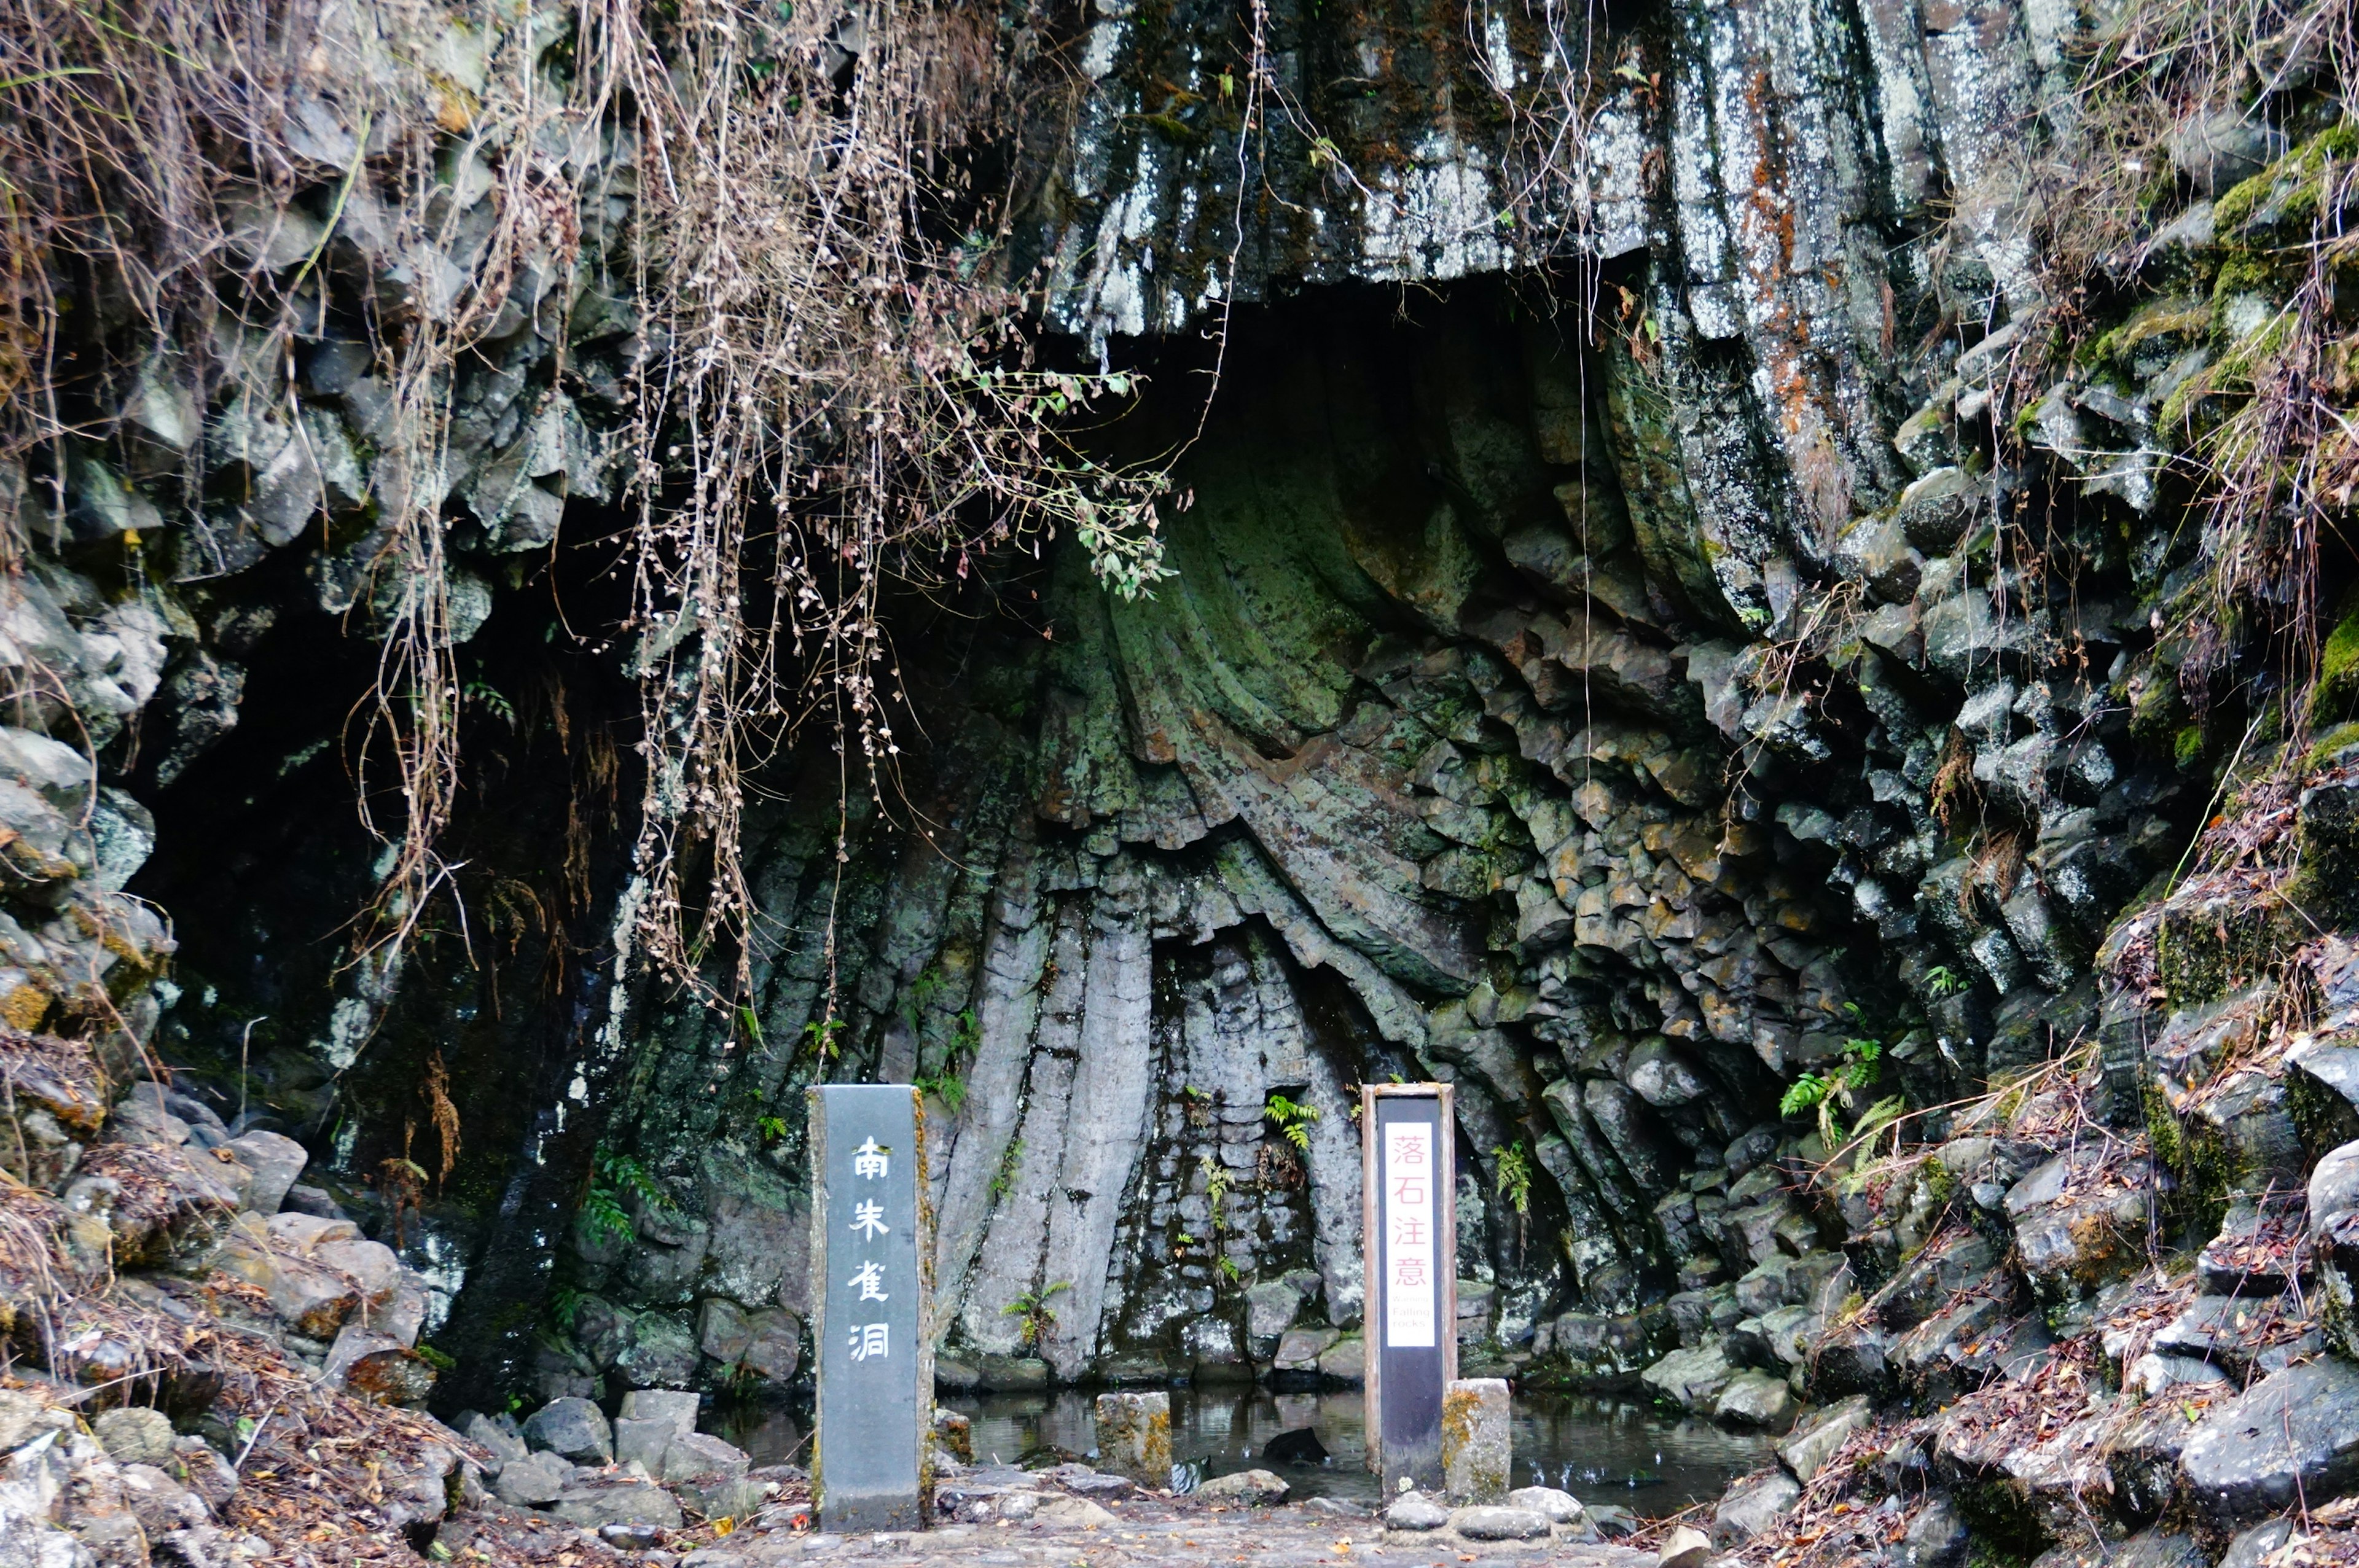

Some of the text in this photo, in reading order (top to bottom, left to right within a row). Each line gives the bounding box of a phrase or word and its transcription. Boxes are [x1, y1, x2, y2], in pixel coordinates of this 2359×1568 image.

[1394, 1135, 1426, 1286] 落石注意
[848, 1135, 891, 1362] 南朱雀洞
[1393, 1295, 1429, 1304] Warning
[1393, 1307, 1430, 1319] Falling
[1393, 1319, 1426, 1328] rocks
